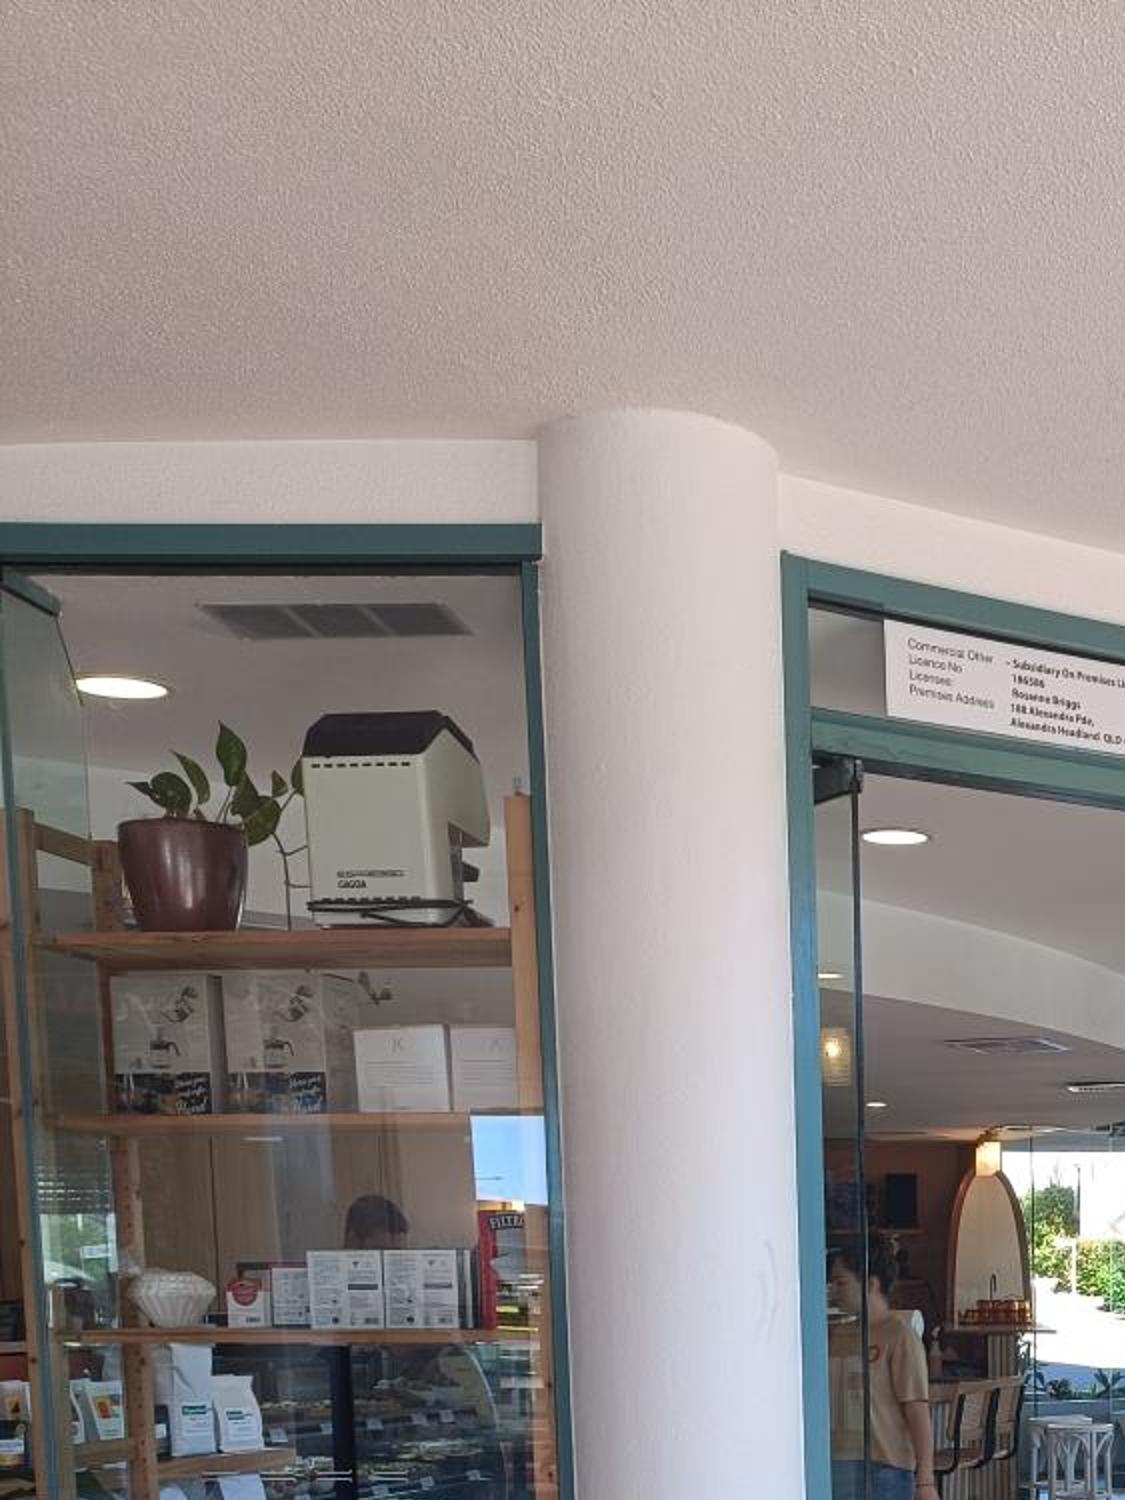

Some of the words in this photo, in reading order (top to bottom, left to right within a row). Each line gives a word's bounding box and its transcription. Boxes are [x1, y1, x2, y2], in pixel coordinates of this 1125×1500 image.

[1012, 657, 1060, 678] Subsidiary
[1062, 667, 1075, 680] On
[1077, 670, 1115, 688] Premises
[956, 692, 994, 710] Address
[1029, 705, 1074, 724] Alexandra
[1010, 716, 1057, 736] Alexandra
[1104, 732, 1122, 746] QLD
